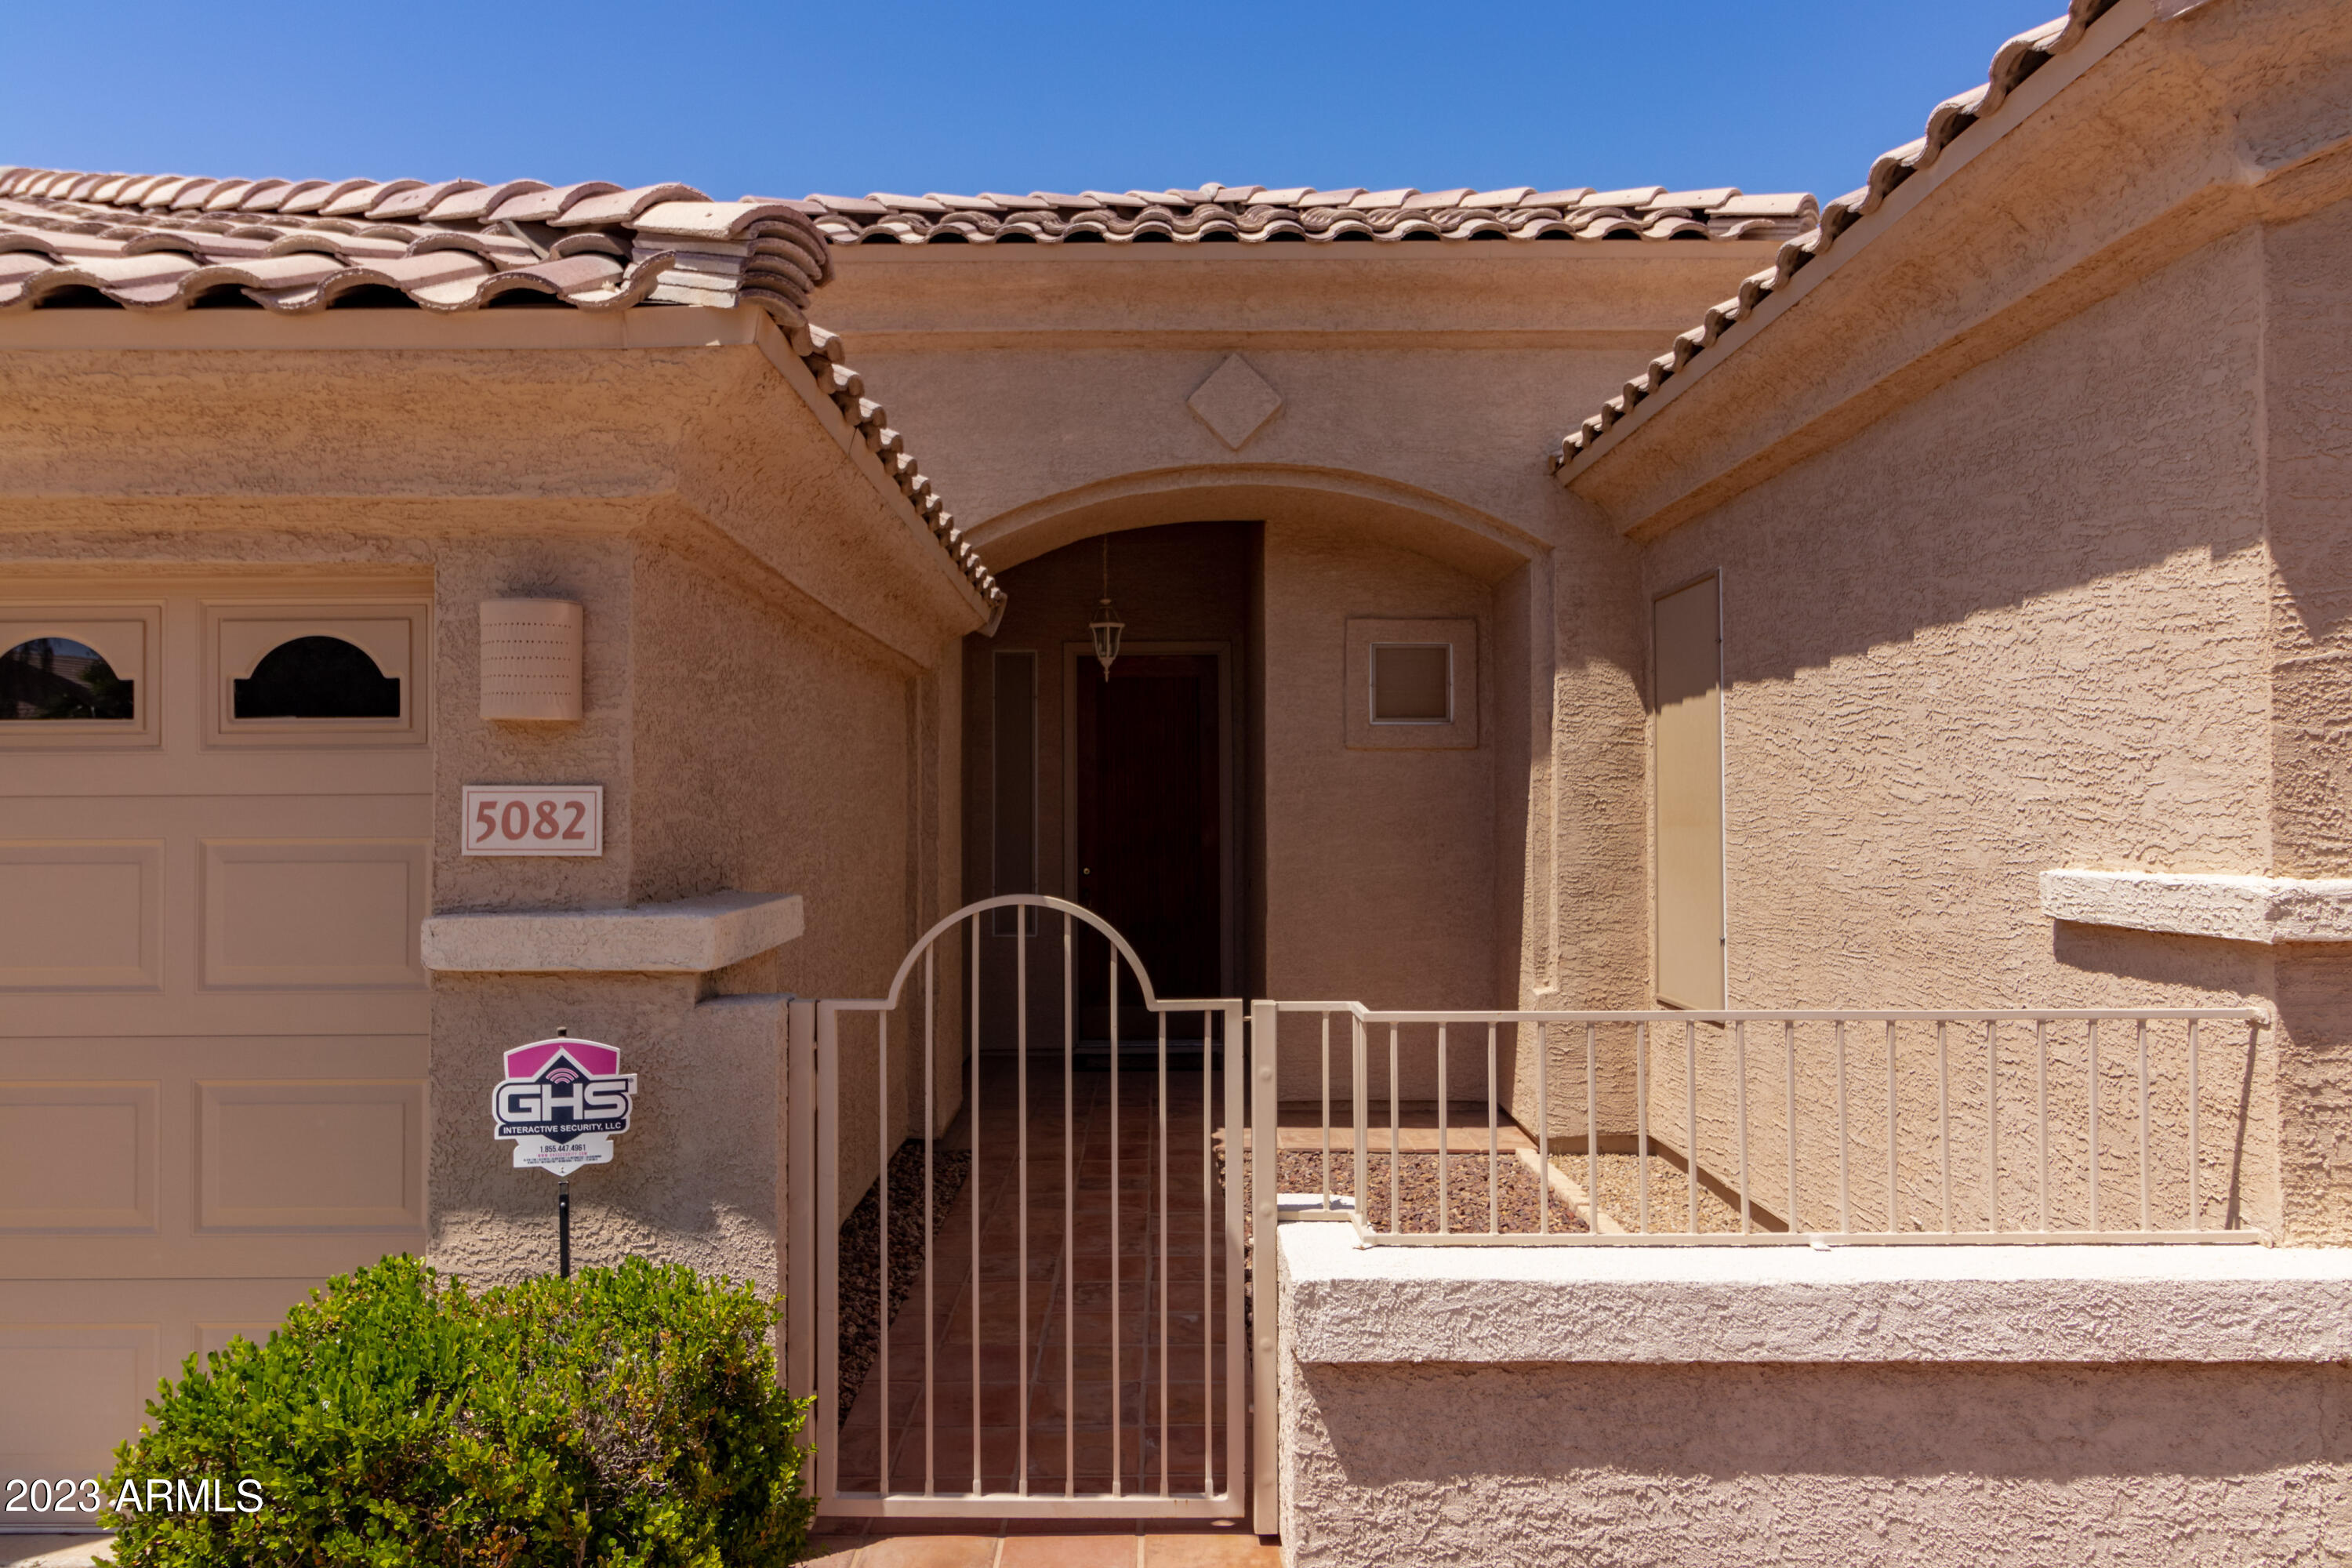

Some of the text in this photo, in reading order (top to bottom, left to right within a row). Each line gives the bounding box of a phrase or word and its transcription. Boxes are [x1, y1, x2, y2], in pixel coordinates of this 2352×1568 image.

[476, 800, 586, 844] 5082
[498, 1079, 626, 1122] GHS
[503, 1124, 559, 1134] INTERACTIVE
[560, 1123, 604, 1133] SECURITY,
[539, 1144, 586, 1153] 1.855.447.4961
